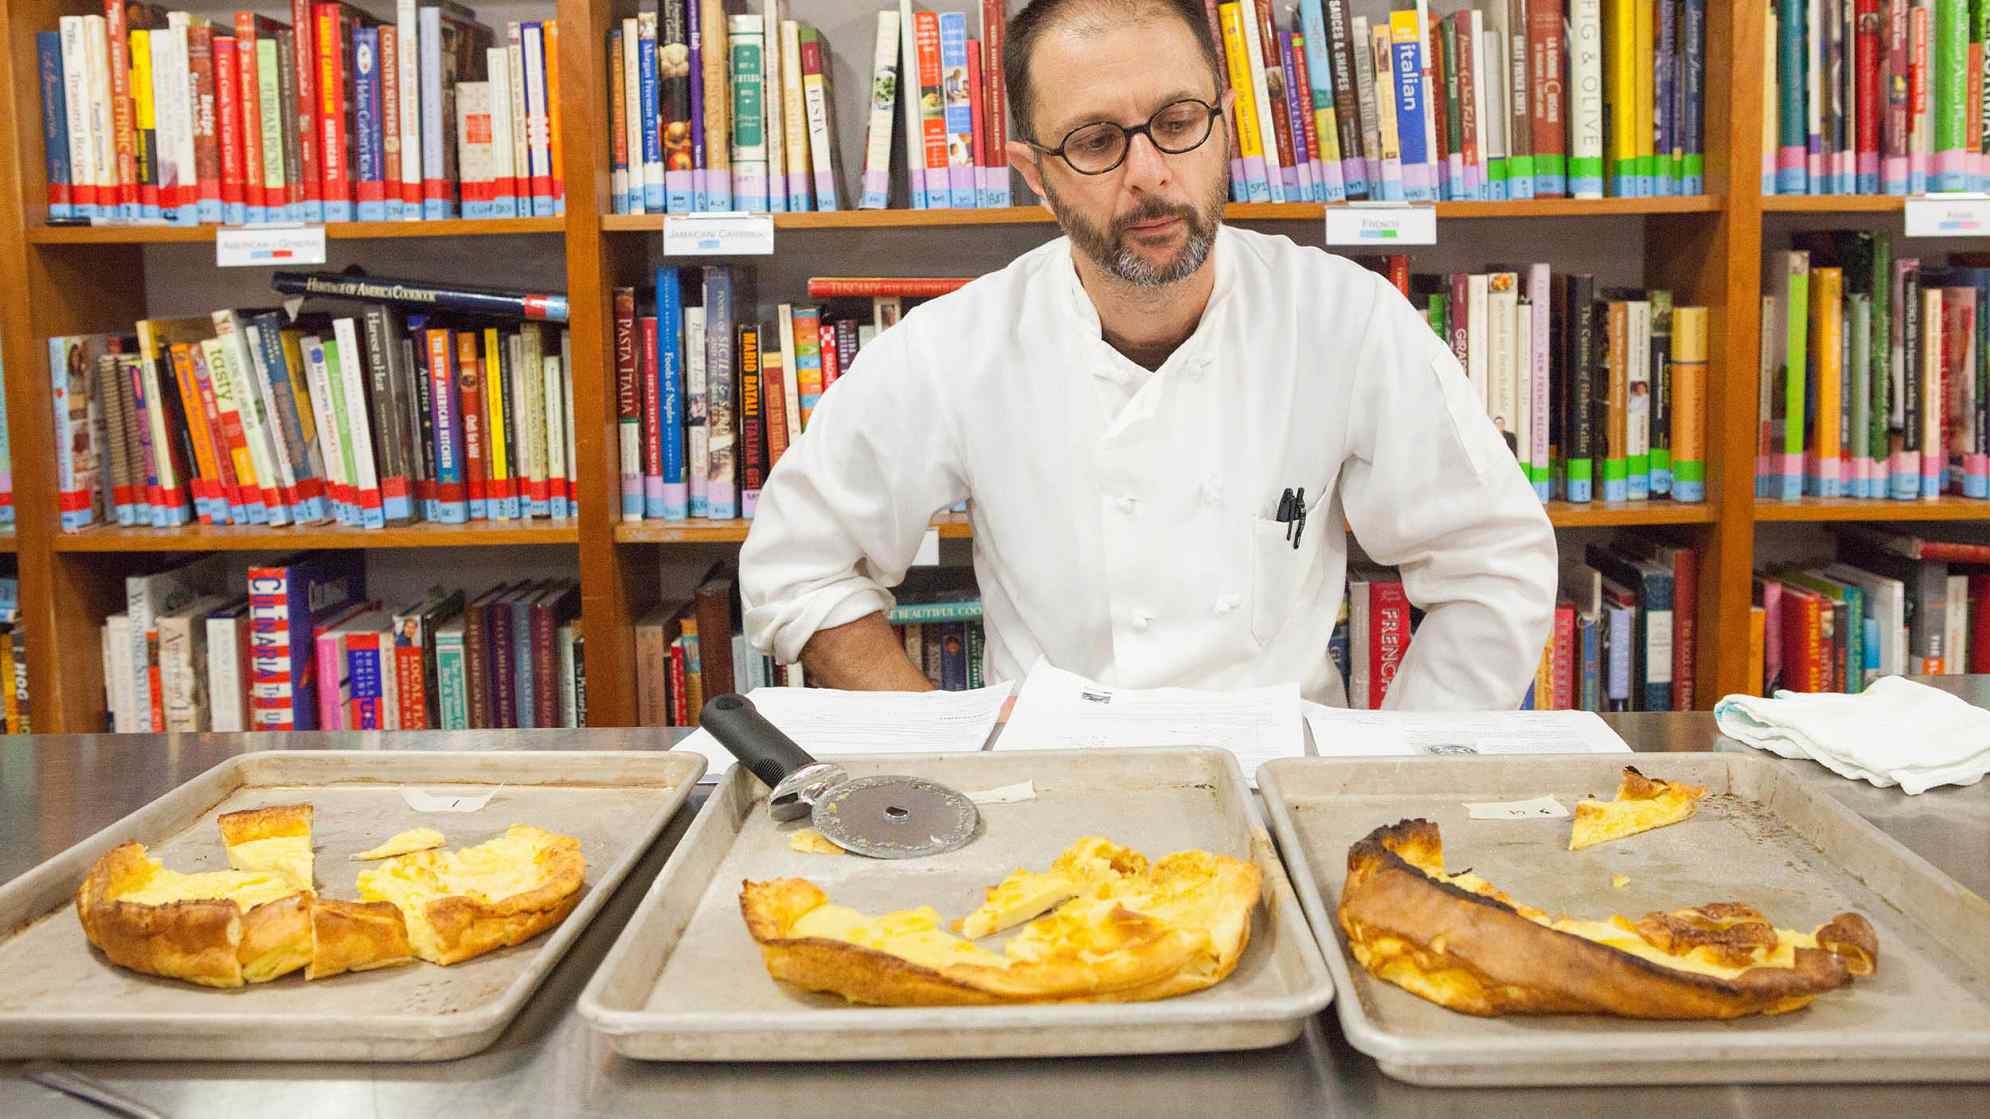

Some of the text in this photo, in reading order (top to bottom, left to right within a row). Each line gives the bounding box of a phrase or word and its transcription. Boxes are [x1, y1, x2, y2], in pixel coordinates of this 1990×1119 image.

[1331, 0, 1343, 39] SAUCES
[383, 33, 395, 85] COUNTRY
[642, 43, 653, 78] Morgan
[1336, 53, 1349, 91] SHAPES
[1400, 45, 1418, 111] italian
[1583, 1, 1598, 146] FIG & OLIVE
[645, 80, 655, 117] Freeman
[808, 89, 822, 136] FESTA
[1302, 97, 1313, 139] NORTH
[114, 96, 131, 152] ETHNIC
[1290, 101, 1304, 153] VENICE
[356, 282, 392, 299] AMERICA
[1581, 305, 1591, 325] The
[367, 312, 386, 392] Harvest to Heat
[618, 319, 635, 414] PASTA ITALIA
[718, 336, 731, 381] SICILY
[743, 332, 758, 372] MARIO
[1581, 328, 1591, 367] Cuisine
[209, 348, 234, 401] tasty
[419, 368, 430, 412] America
[664, 352, 676, 424] Foods of Naples
[744, 376, 759, 416] BATALI
[433, 337, 451, 469] THE NEW AMERICAN KITCHEN
[1581, 384, 1591, 419] Hubert
[719, 400, 731, 465] SARDIA
[745, 420, 759, 463] ITALIAN
[1580, 423, 1591, 454] Keller
[252, 577, 283, 682] CULINARIA
[1930, 635, 1940, 656] THE
[365, 651, 374, 696] SHEILA
[411, 655, 421, 730] LOCAL FLA
